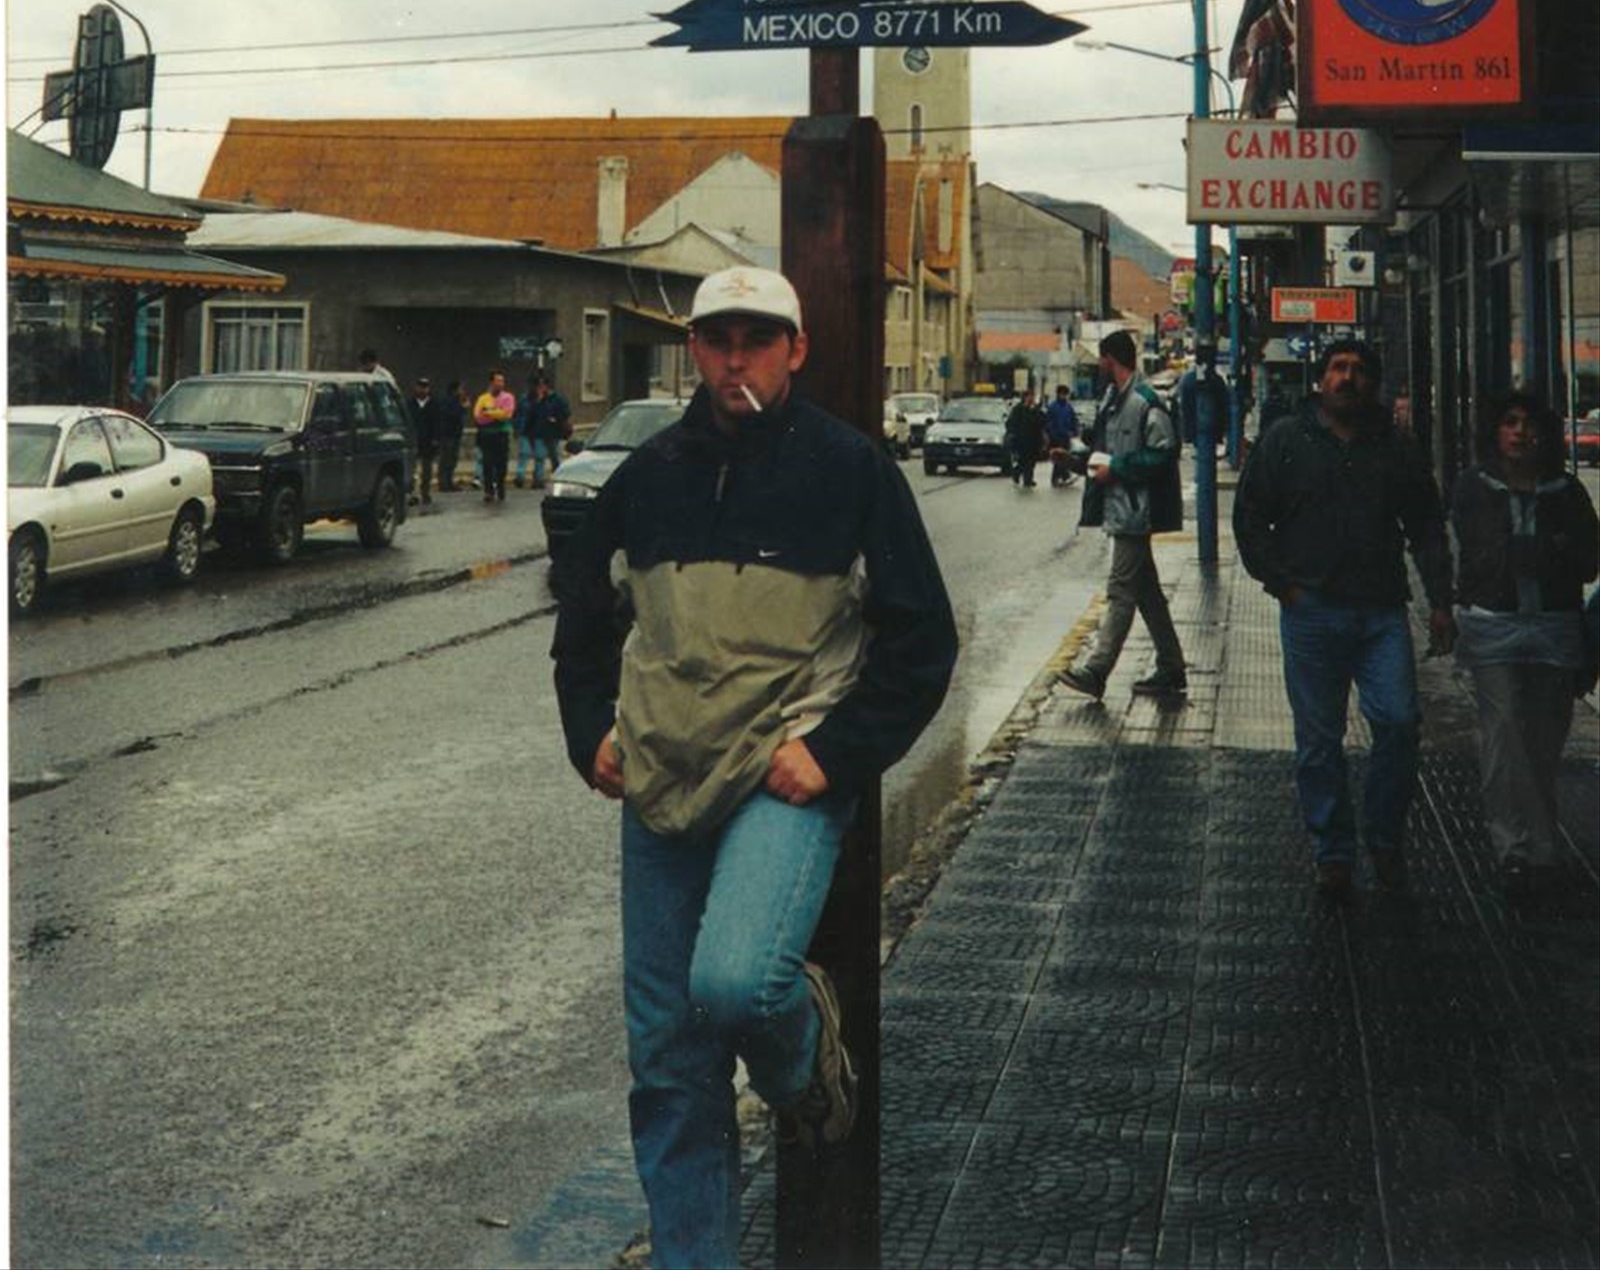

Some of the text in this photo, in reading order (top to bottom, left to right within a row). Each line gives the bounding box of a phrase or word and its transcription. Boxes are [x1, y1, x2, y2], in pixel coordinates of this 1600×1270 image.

[743, 6, 1001, 43] MEXICO 8771 Km
[1325, 58, 1366, 81] San
[1475, 56, 1510, 79] 861
[1226, 131, 1358, 161] CAMBIO
[1201, 180, 1382, 210] EXCHANGE
